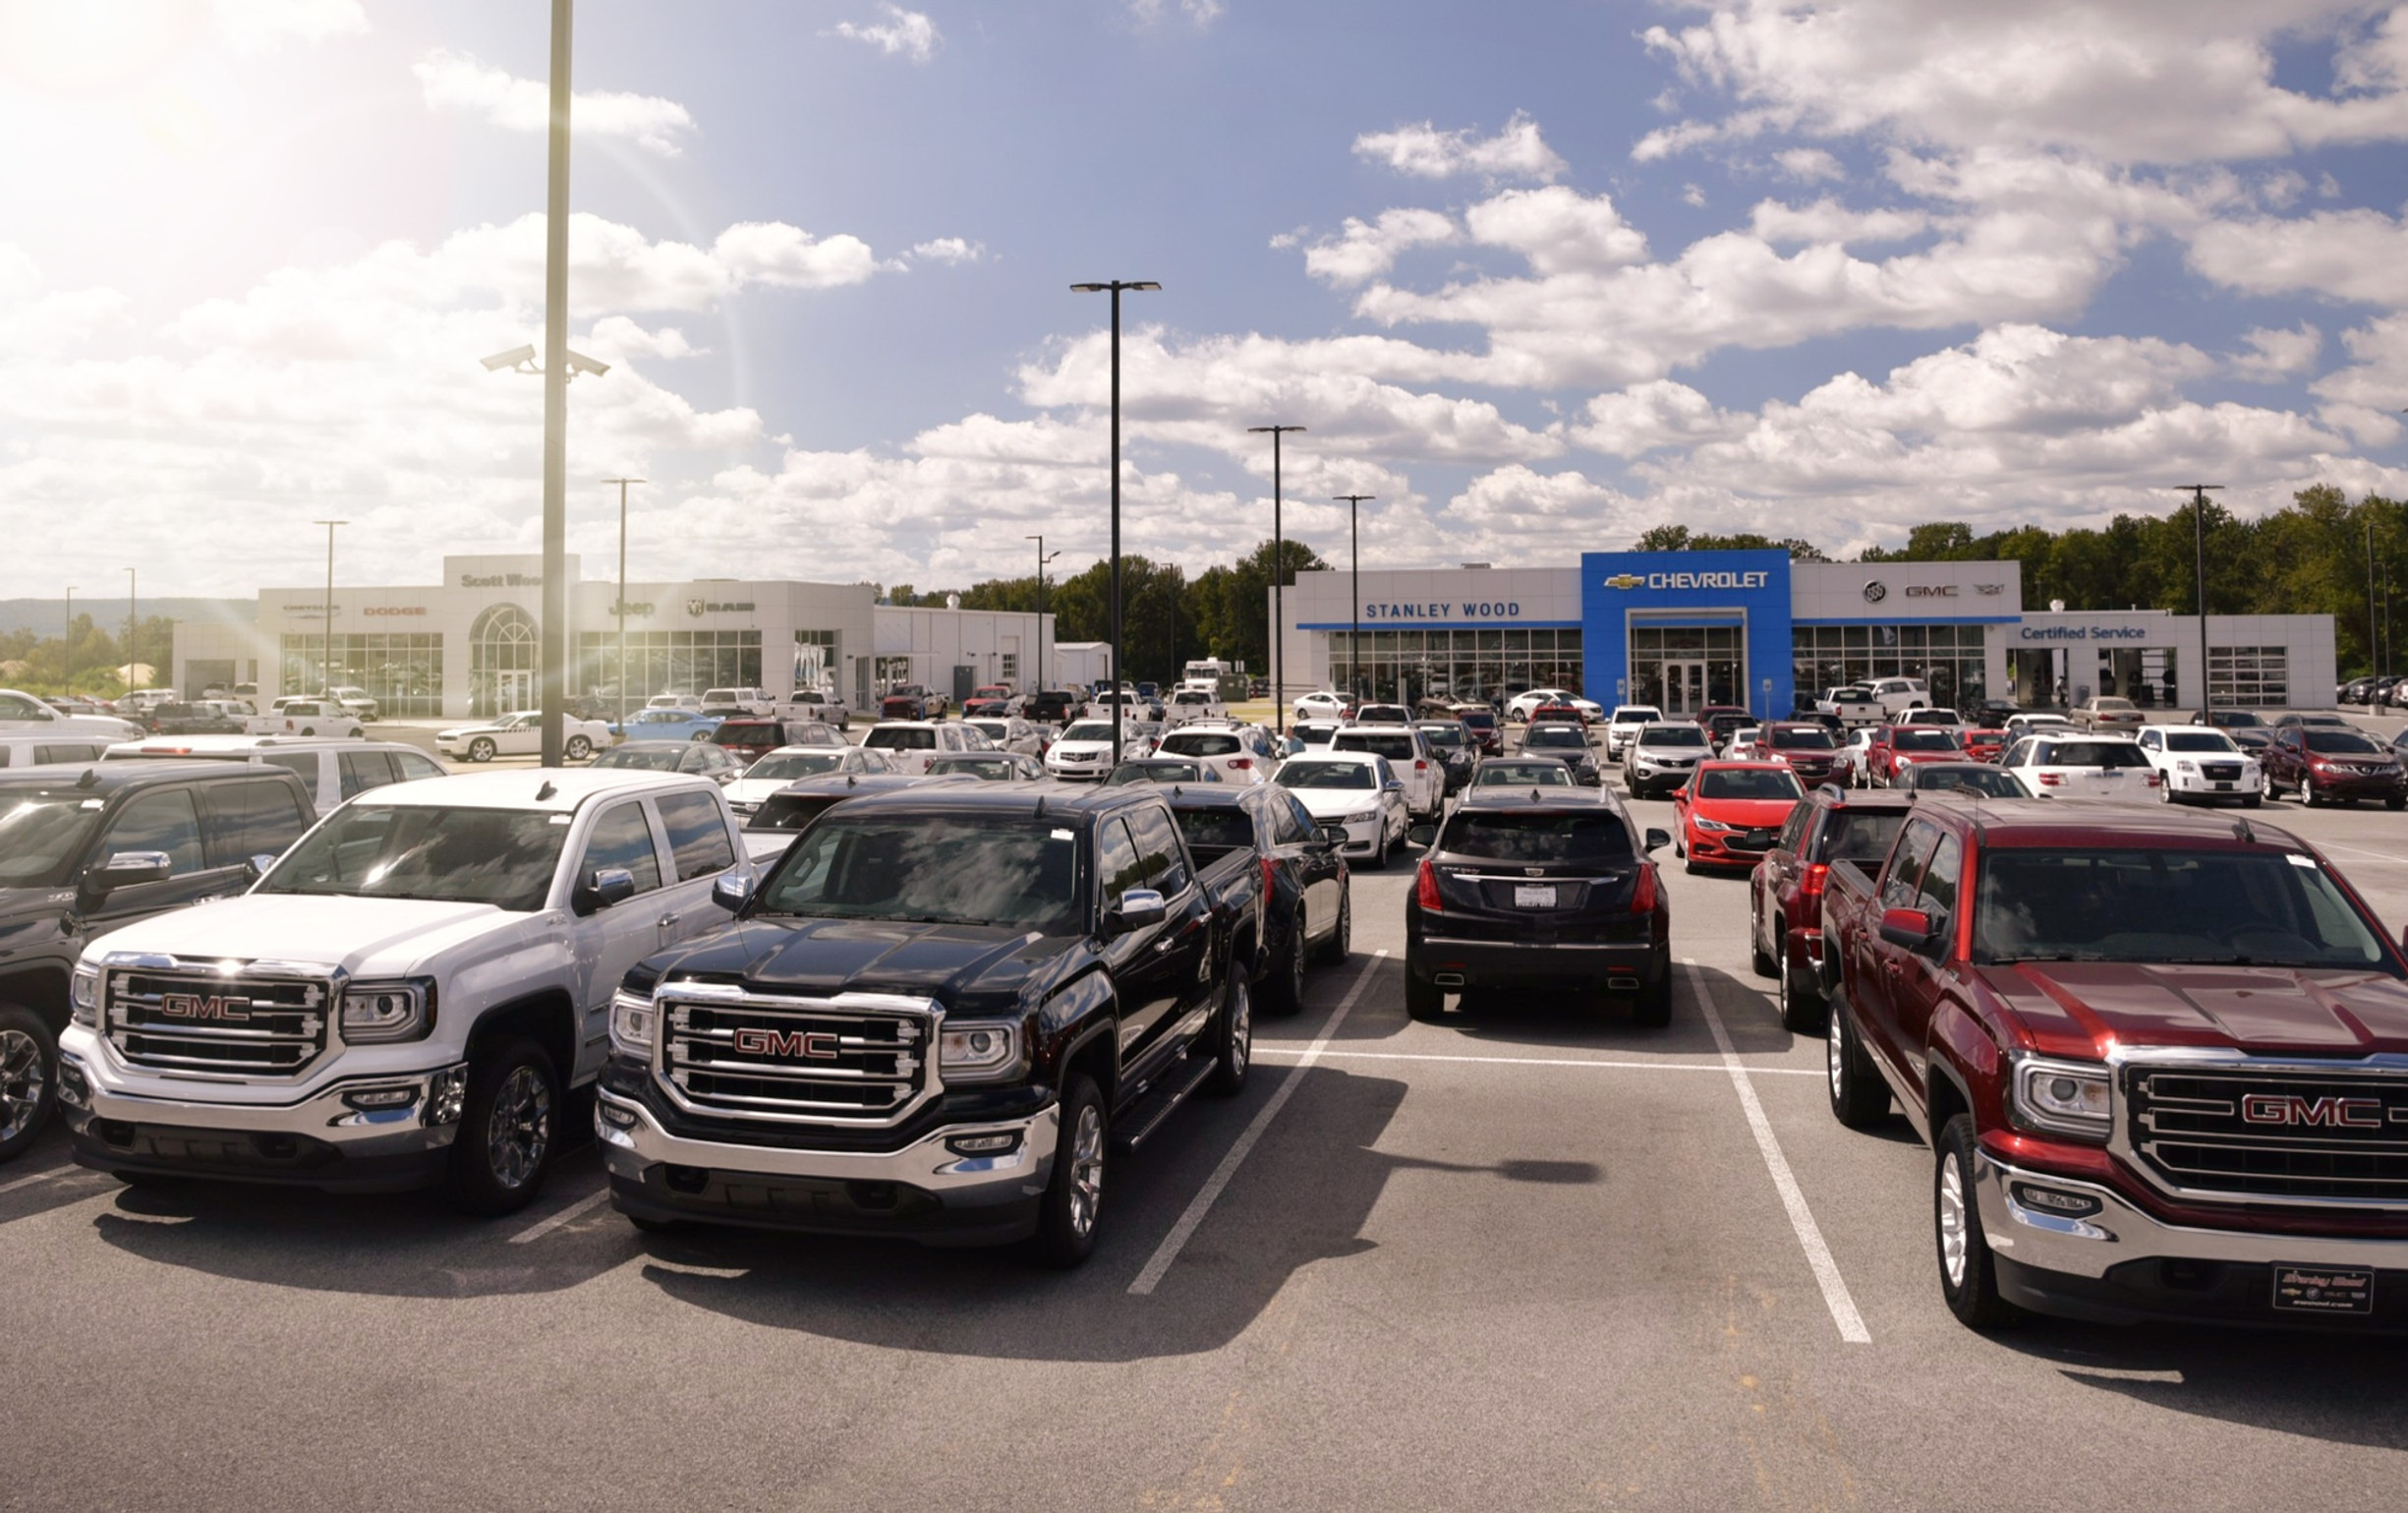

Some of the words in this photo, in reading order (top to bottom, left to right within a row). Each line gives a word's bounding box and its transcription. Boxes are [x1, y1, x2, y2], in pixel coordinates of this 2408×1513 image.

[461, 573, 503, 588] Scott
[505, 573, 543, 587] Woo
[1648, 571, 1769, 589] CHEVROLET
[1905, 585, 1959, 598] GMC
[363, 607, 427, 616] DODGE
[608, 598, 655, 617] Jeep
[1366, 603, 1451, 618] STANLEY
[1462, 602, 1519, 617] WOOD
[2021, 626, 2086, 640] Certified
[2091, 625, 2146, 639] Service
[161, 993, 250, 1021] GMC
[734, 1027, 837, 1060] GMC
[2242, 1093, 2381, 1128] GMC
